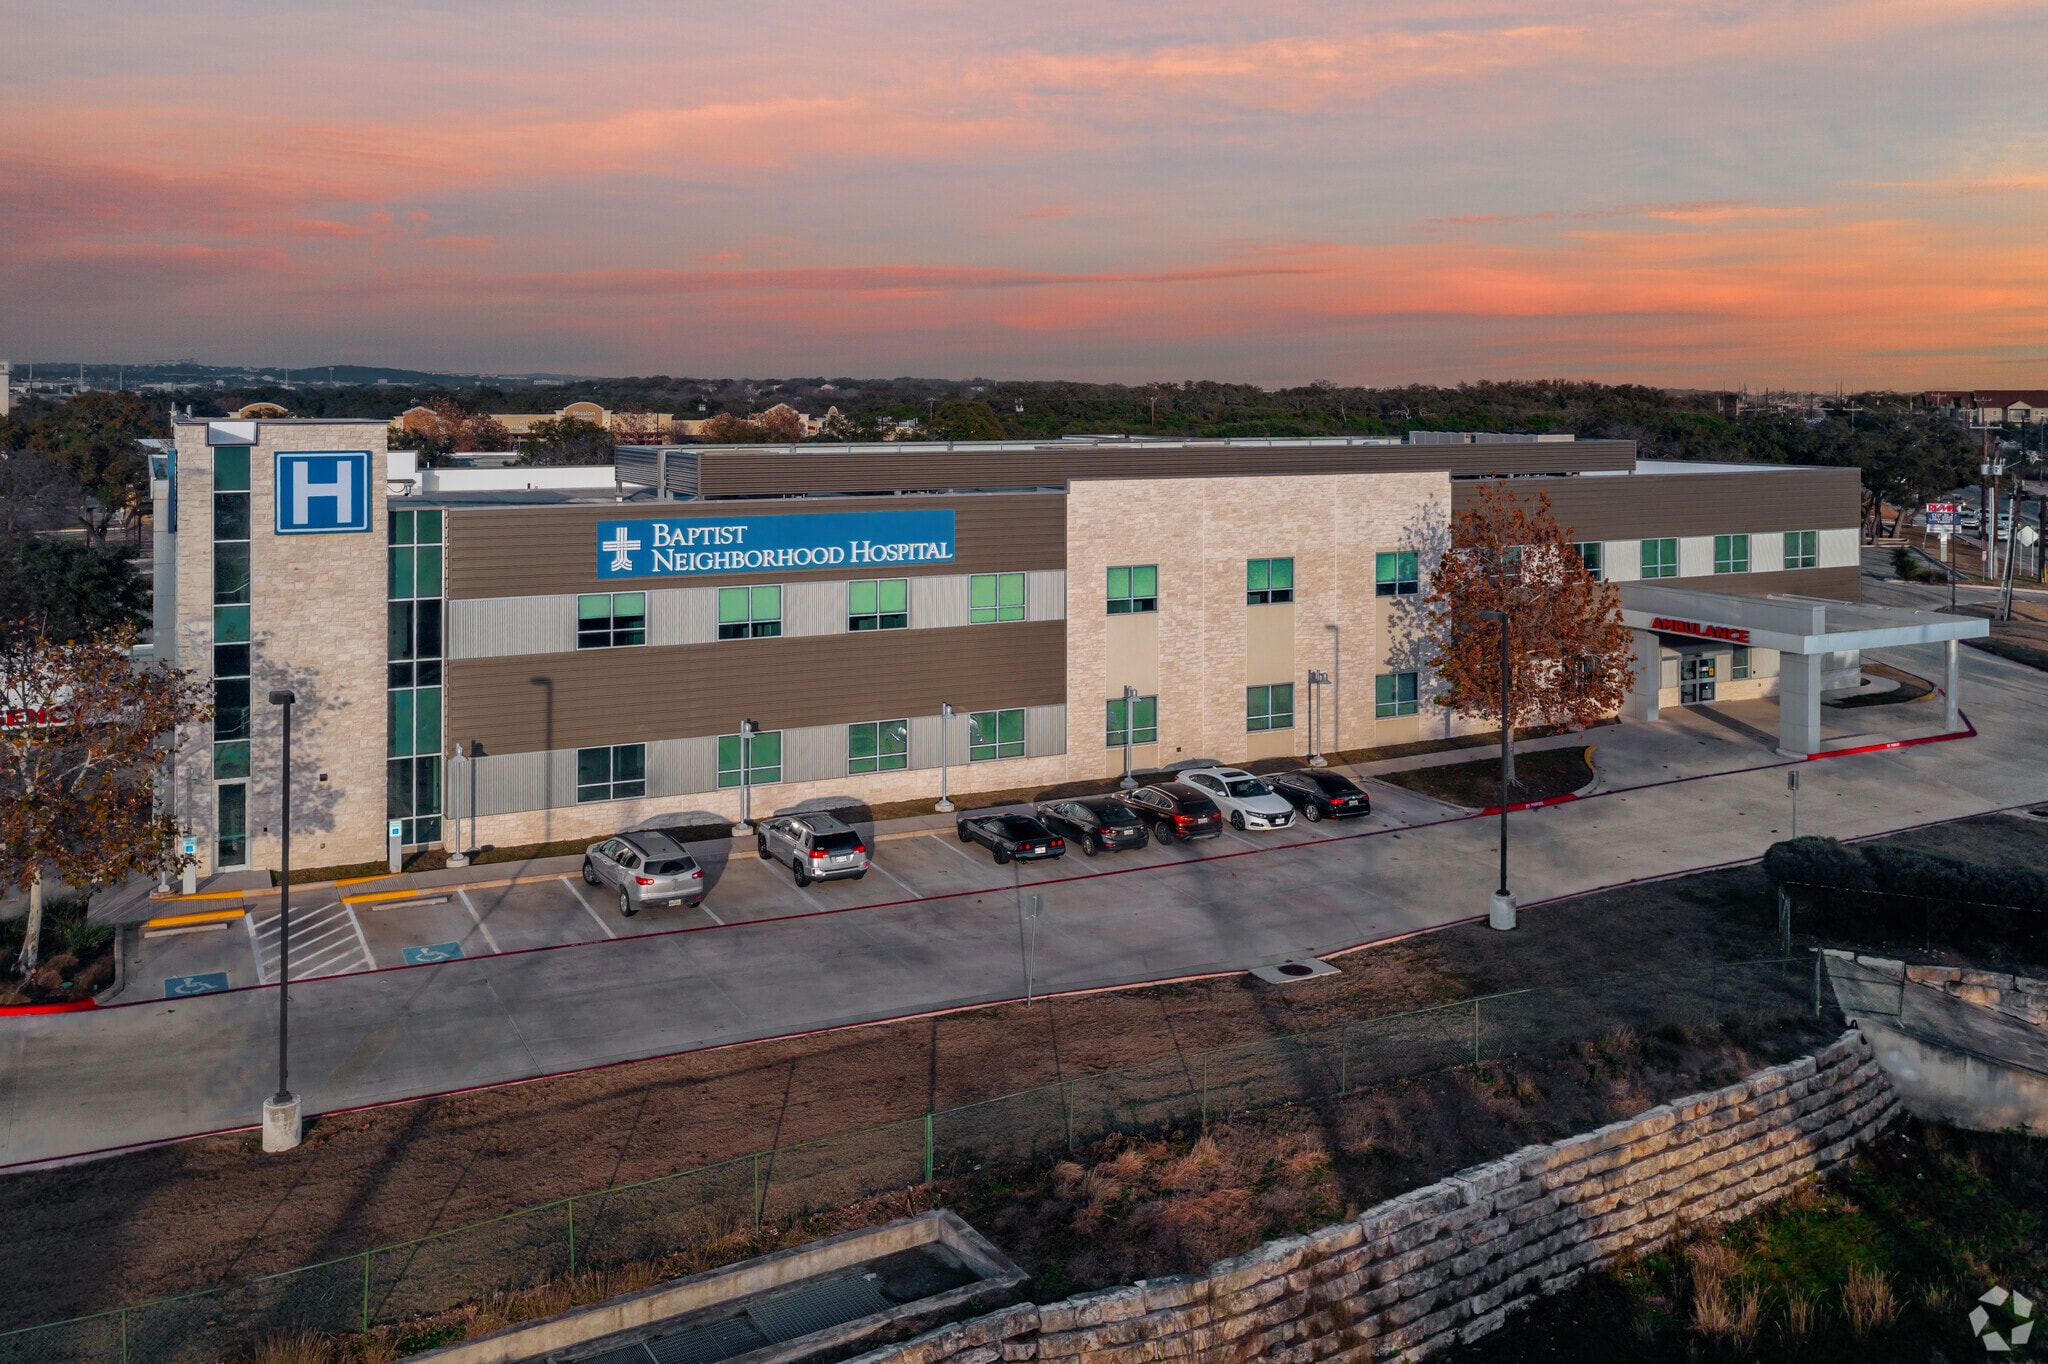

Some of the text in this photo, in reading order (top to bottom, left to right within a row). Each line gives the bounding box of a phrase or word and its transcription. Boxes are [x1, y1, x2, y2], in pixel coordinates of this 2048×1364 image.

[293, 461, 352, 524] H
[652, 523, 748, 547] BAPTIST
[651, 540, 953, 572] NEIGHBORHOOD HOSPITAL
[1651, 617, 1750, 643] AMBULANCE
[0, 704, 84, 726] ENCY
